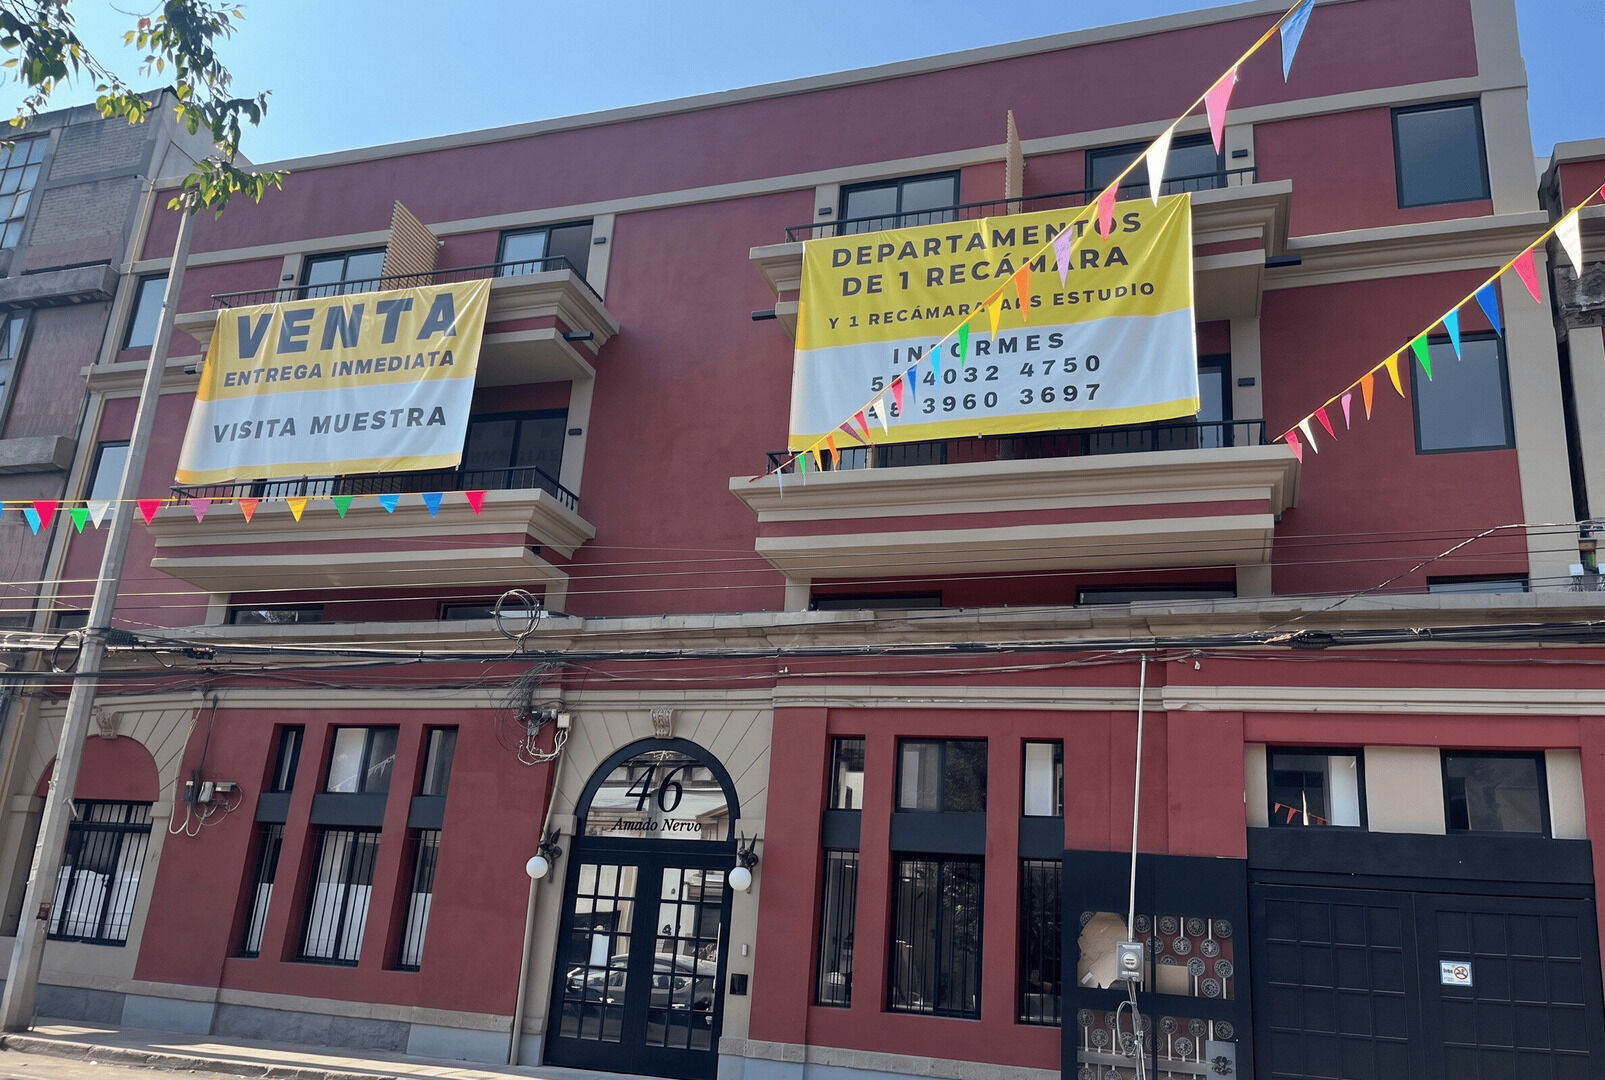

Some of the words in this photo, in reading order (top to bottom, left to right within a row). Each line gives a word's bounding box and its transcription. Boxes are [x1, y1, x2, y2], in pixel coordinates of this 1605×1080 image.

[832, 212, 1142, 268] DEPARTAMENTOS
[842, 275, 882, 297] DE
[899, 271, 909, 290] 1
[828, 317, 839, 329] Y
[850, 315, 859, 327] 1
[1053, 282, 1155, 306] ESTUDIO
[237, 292, 457, 360] VENTA
[893, 332, 1064, 364] INORMES
[223, 362, 322, 388] ENTREGA
[331, 350, 454, 378] INMEDIATA
[923, 365, 999, 386] 4032
[1020, 355, 1100, 378] 4750
[922, 391, 998, 414] 3960
[1020, 383, 1101, 405] 3697
[214, 417, 296, 443] VISITA
[309, 406, 447, 435] MUESTRA
[625, 764, 691, 813] 46
[611, 817, 658, 832] Amado
[660, 818, 702, 833] Nervo
